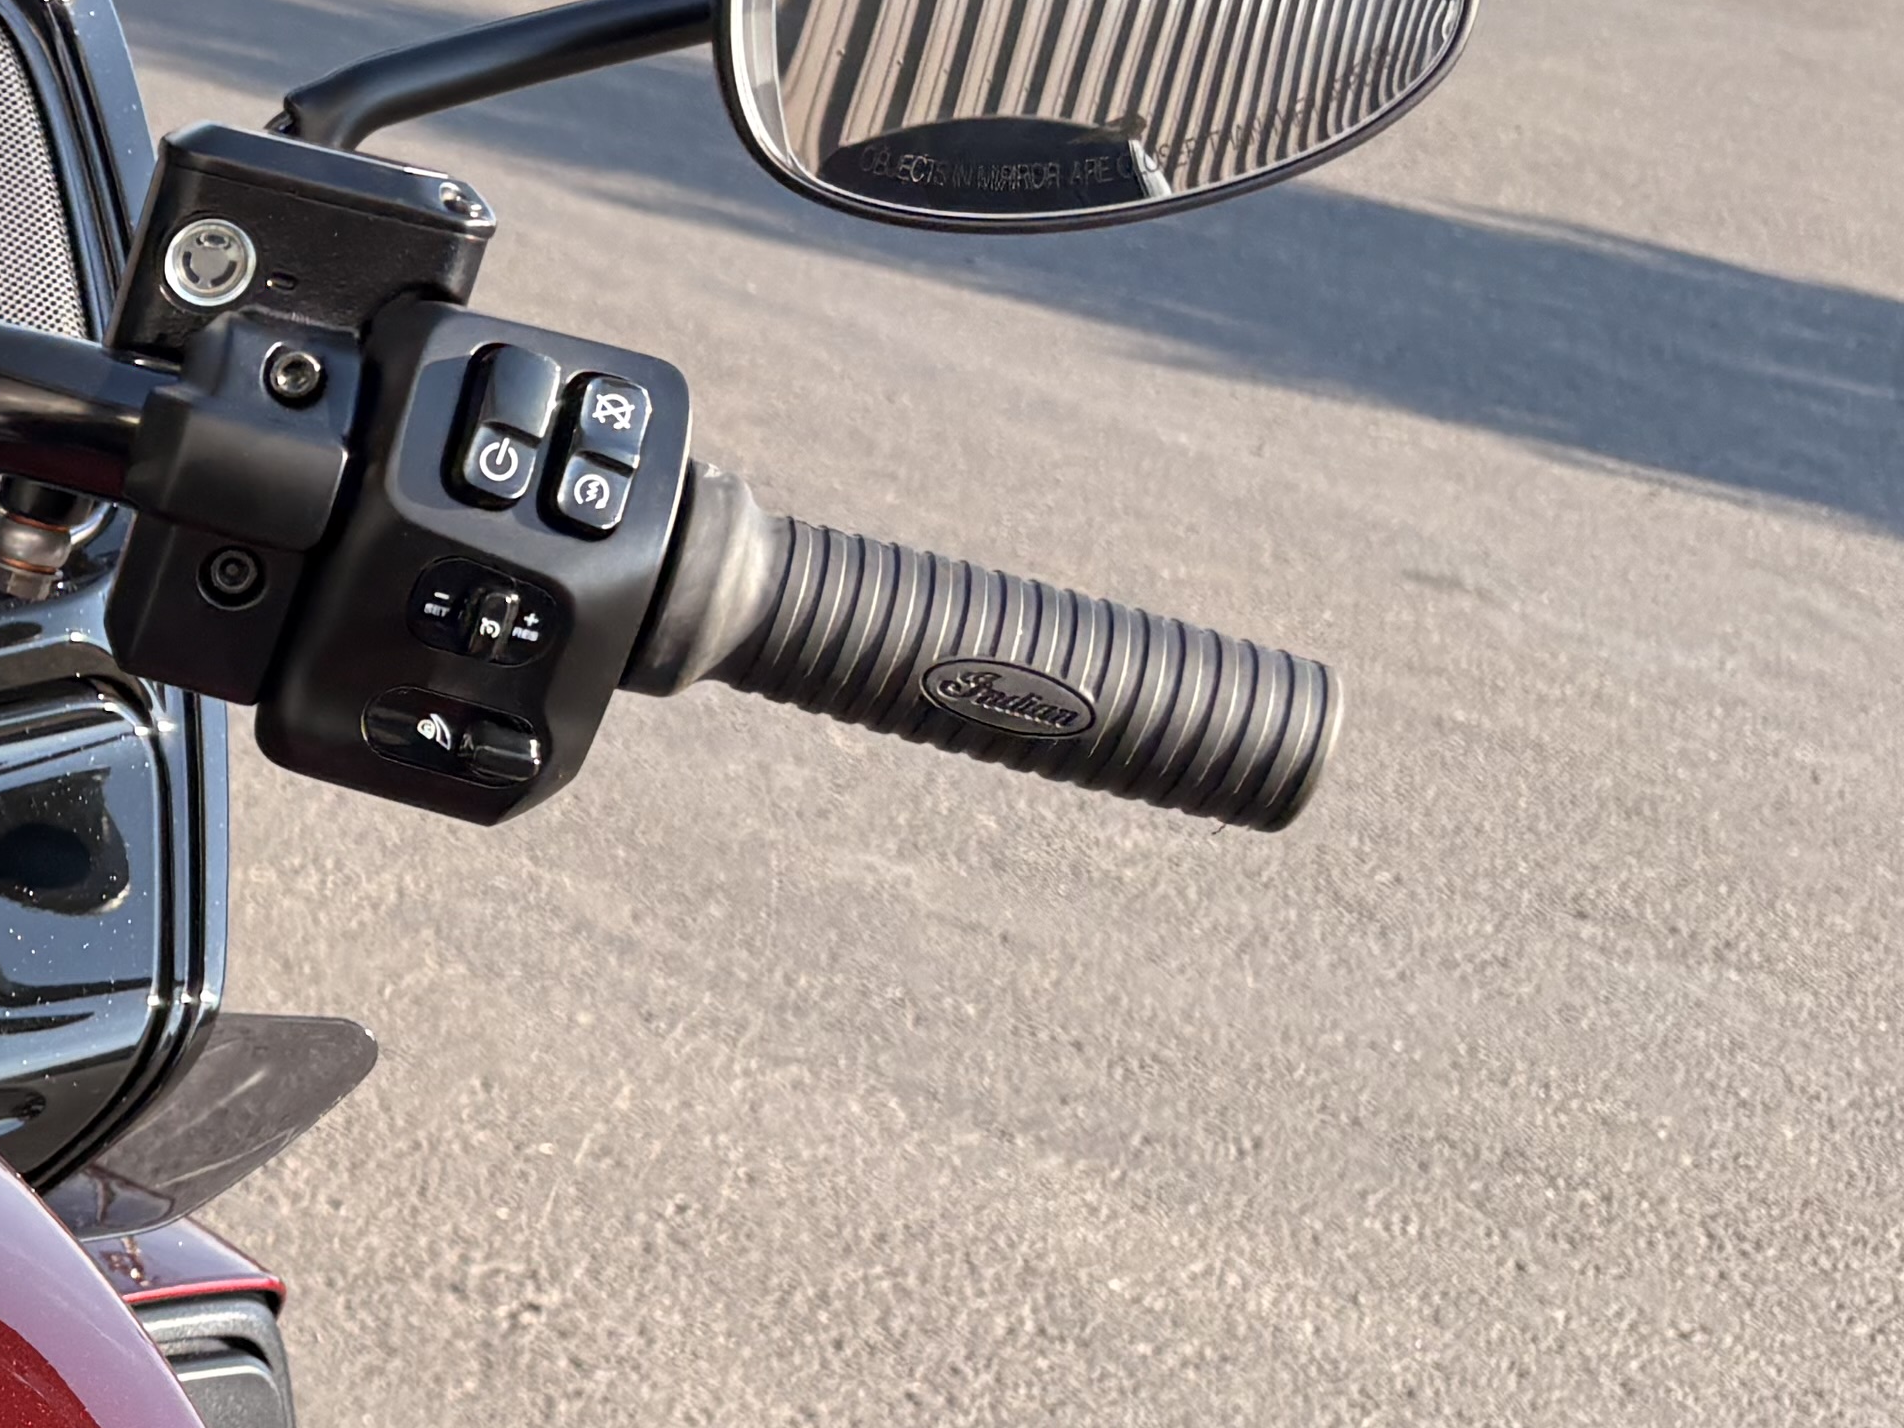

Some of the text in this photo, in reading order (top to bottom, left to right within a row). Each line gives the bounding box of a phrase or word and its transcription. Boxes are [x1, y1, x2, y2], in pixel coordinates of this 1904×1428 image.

[423, 602, 451, 618] SET
[512, 626, 539, 642] RES
[936, 671, 1081, 729] Indian
